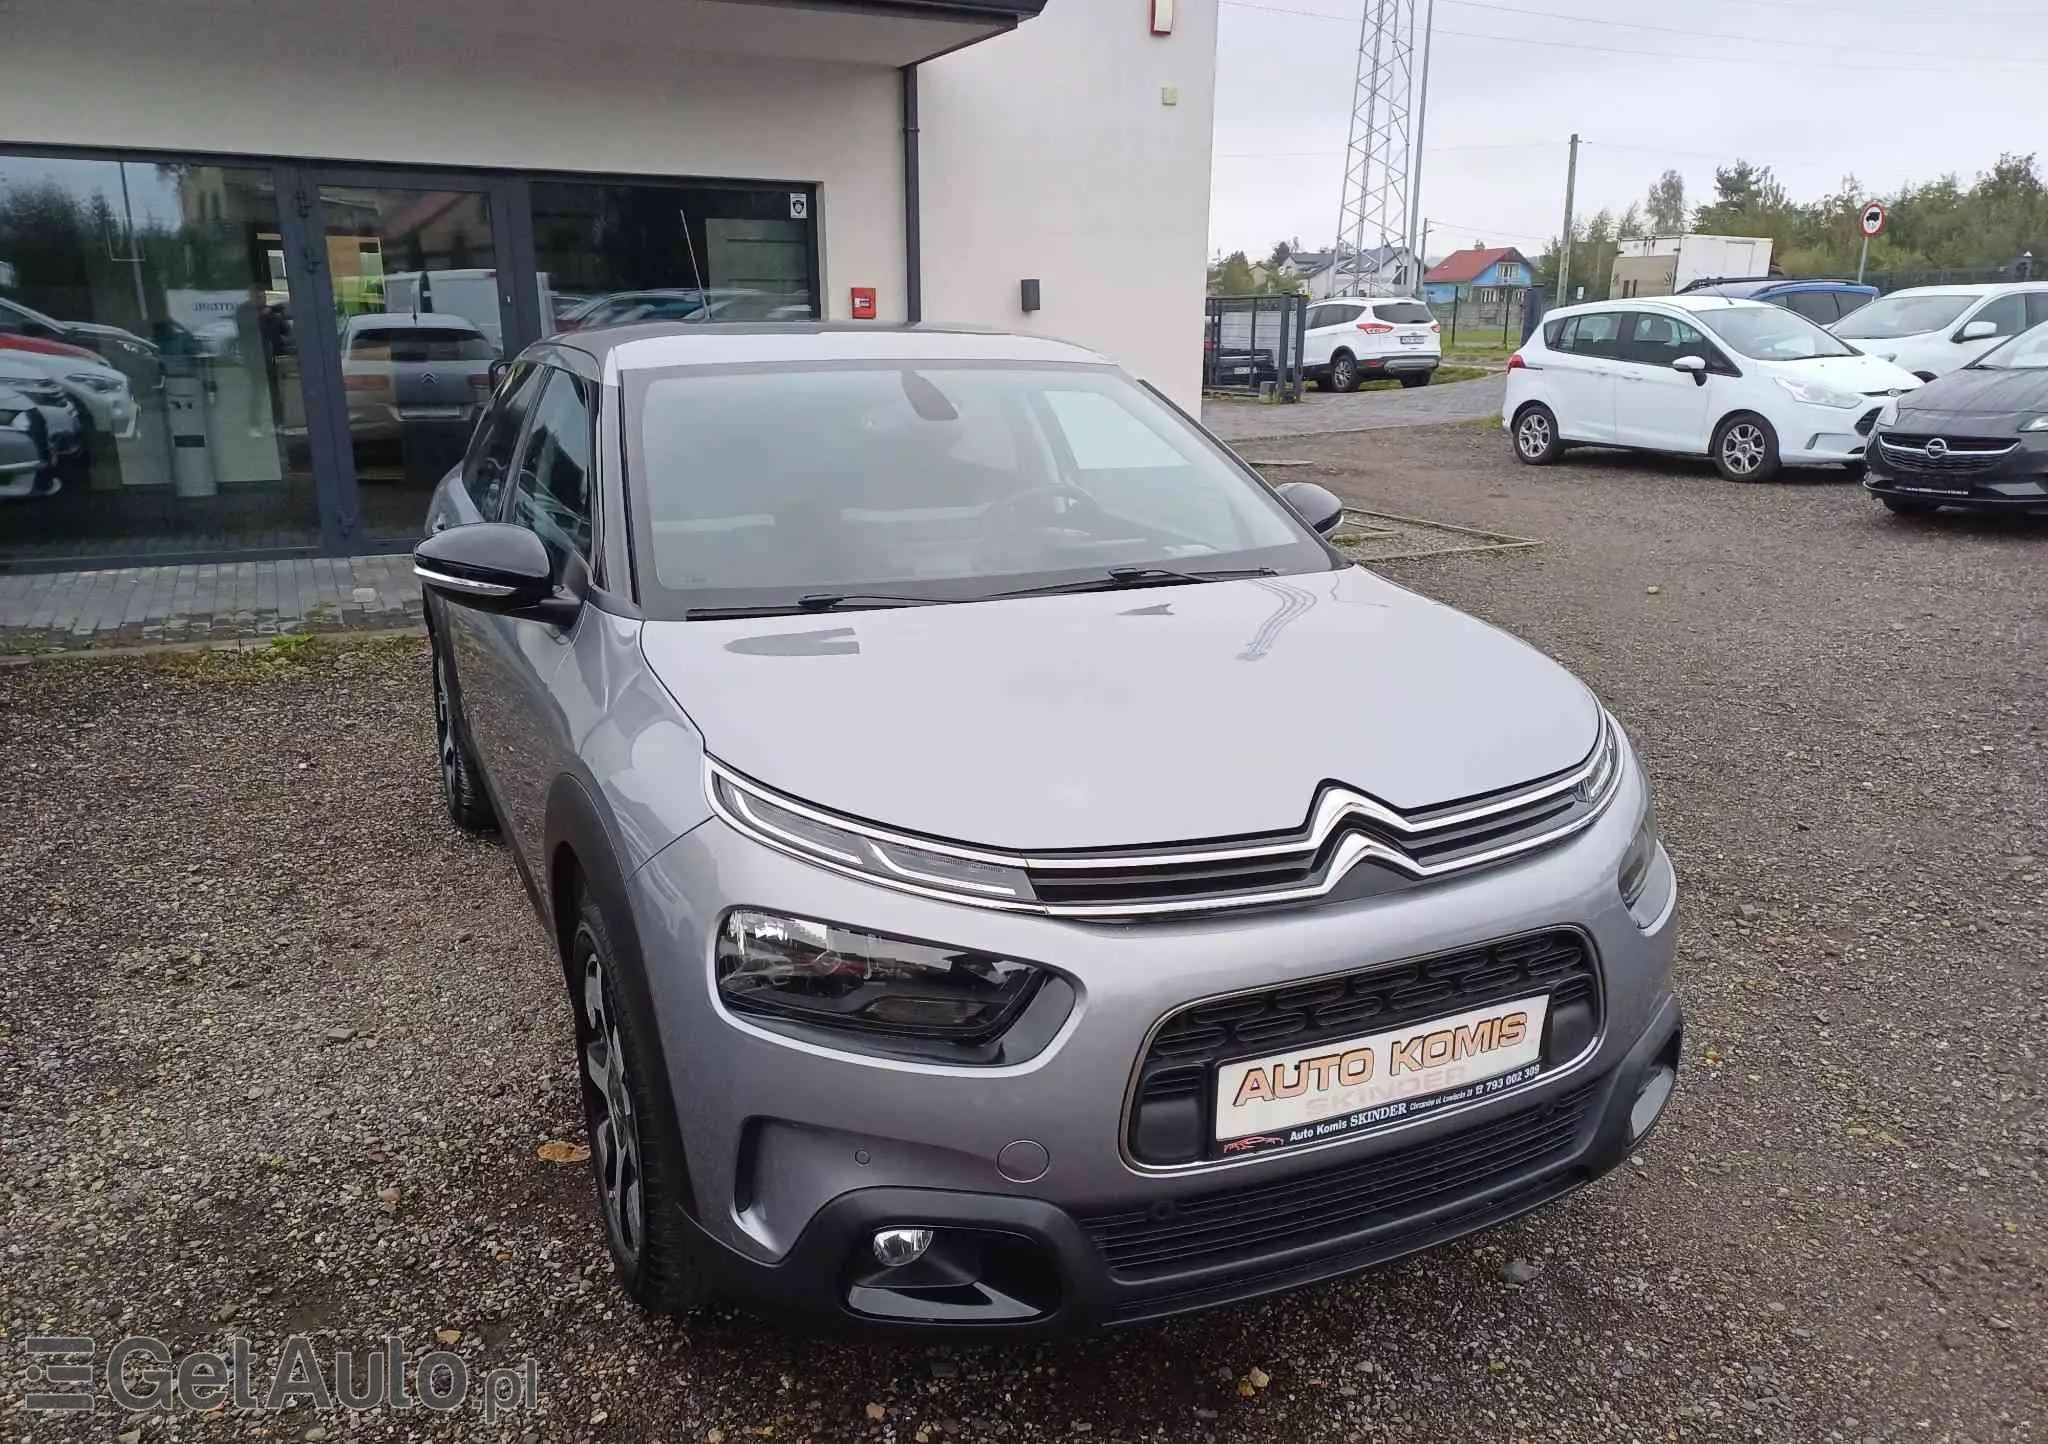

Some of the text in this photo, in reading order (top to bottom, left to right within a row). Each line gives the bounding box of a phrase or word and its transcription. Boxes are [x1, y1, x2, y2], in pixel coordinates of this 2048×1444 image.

[1232, 1011, 1528, 1107] AUTO KOMIS
[1306, 1066, 1466, 1118] SKINDER
[1289, 1129, 1314, 1142] Auto
[1316, 1119, 1347, 1136] Komis
[1350, 1104, 1407, 1126] SKINDER
[1486, 1078, 1504, 1092] 793
[1505, 1071, 1523, 1086] 002
